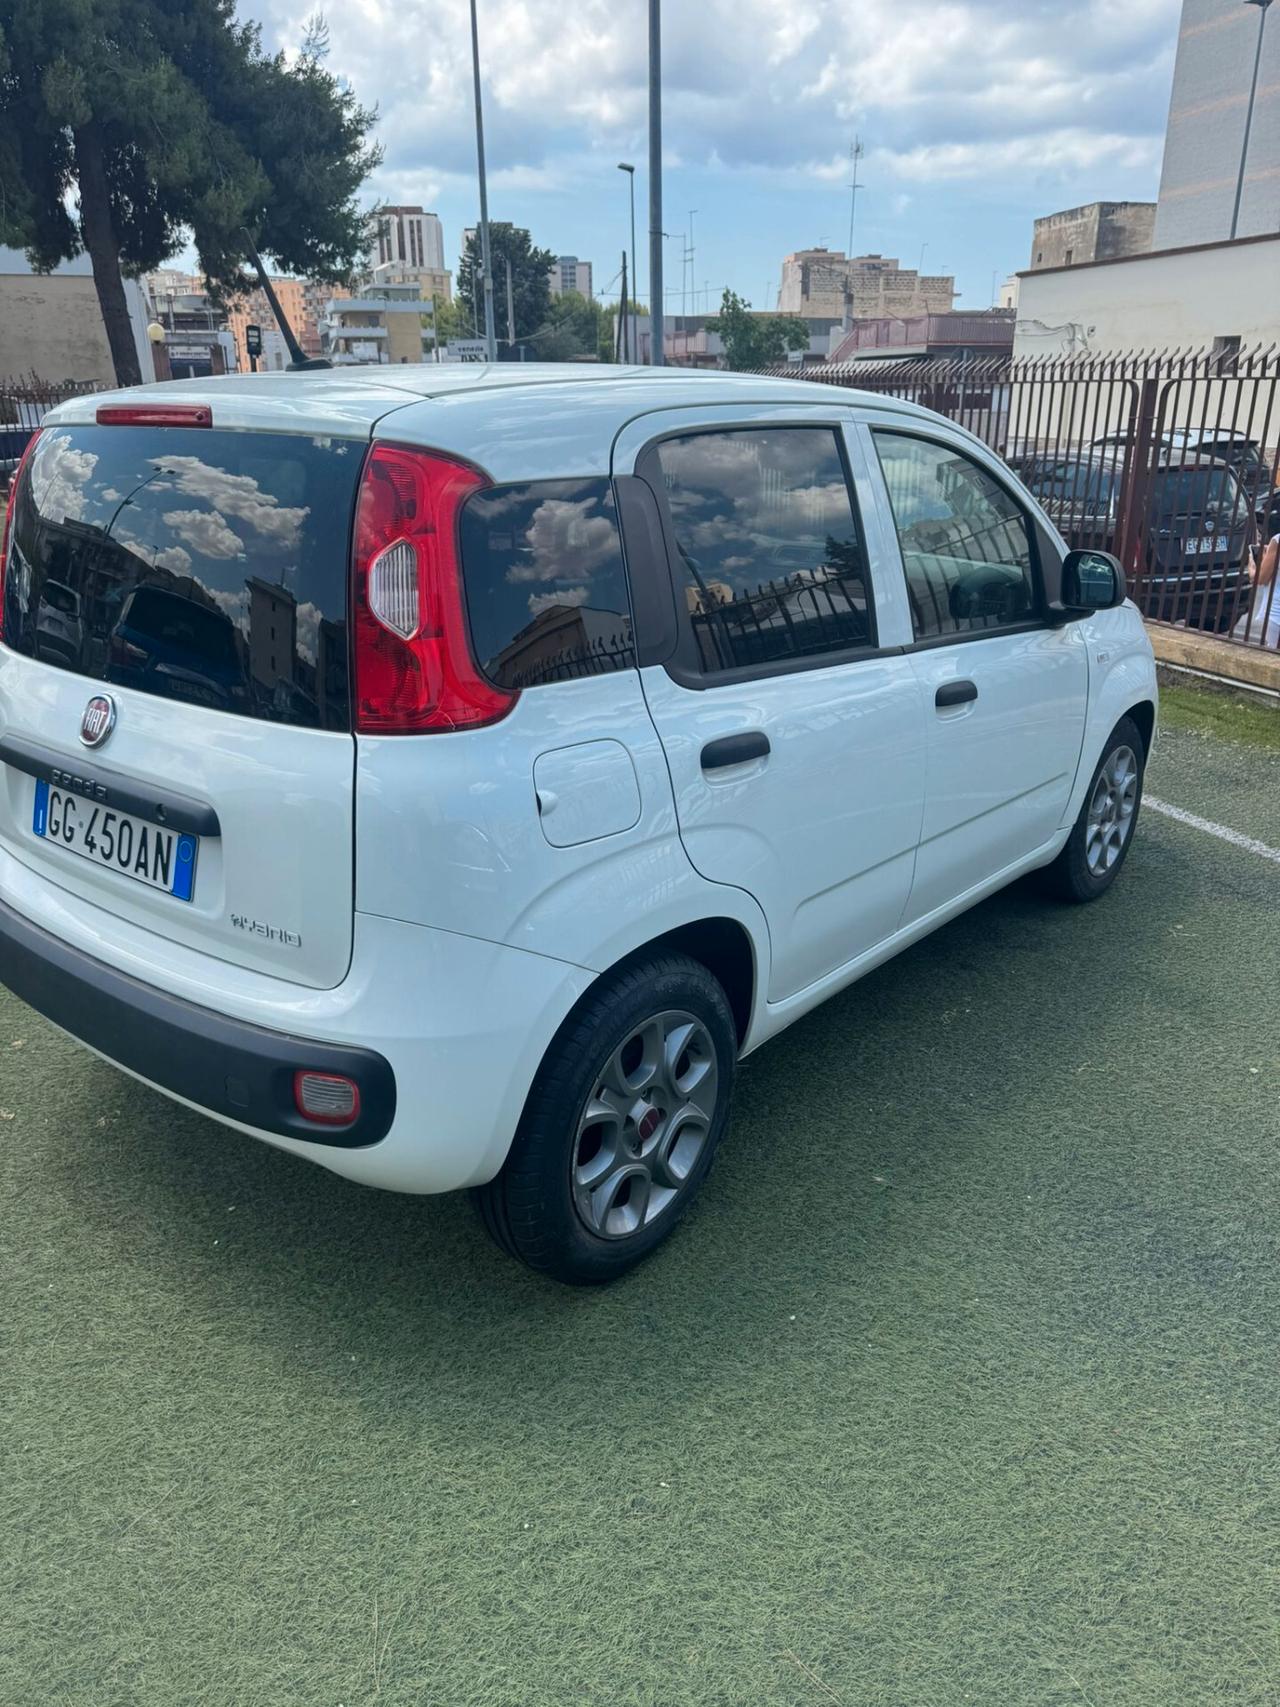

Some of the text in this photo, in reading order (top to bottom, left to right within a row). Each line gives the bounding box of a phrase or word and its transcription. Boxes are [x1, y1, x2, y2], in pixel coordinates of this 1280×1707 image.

[83, 708, 107, 734] FIAT
[52, 769, 108, 800] panda
[49, 791, 172, 885] GG 450AN
